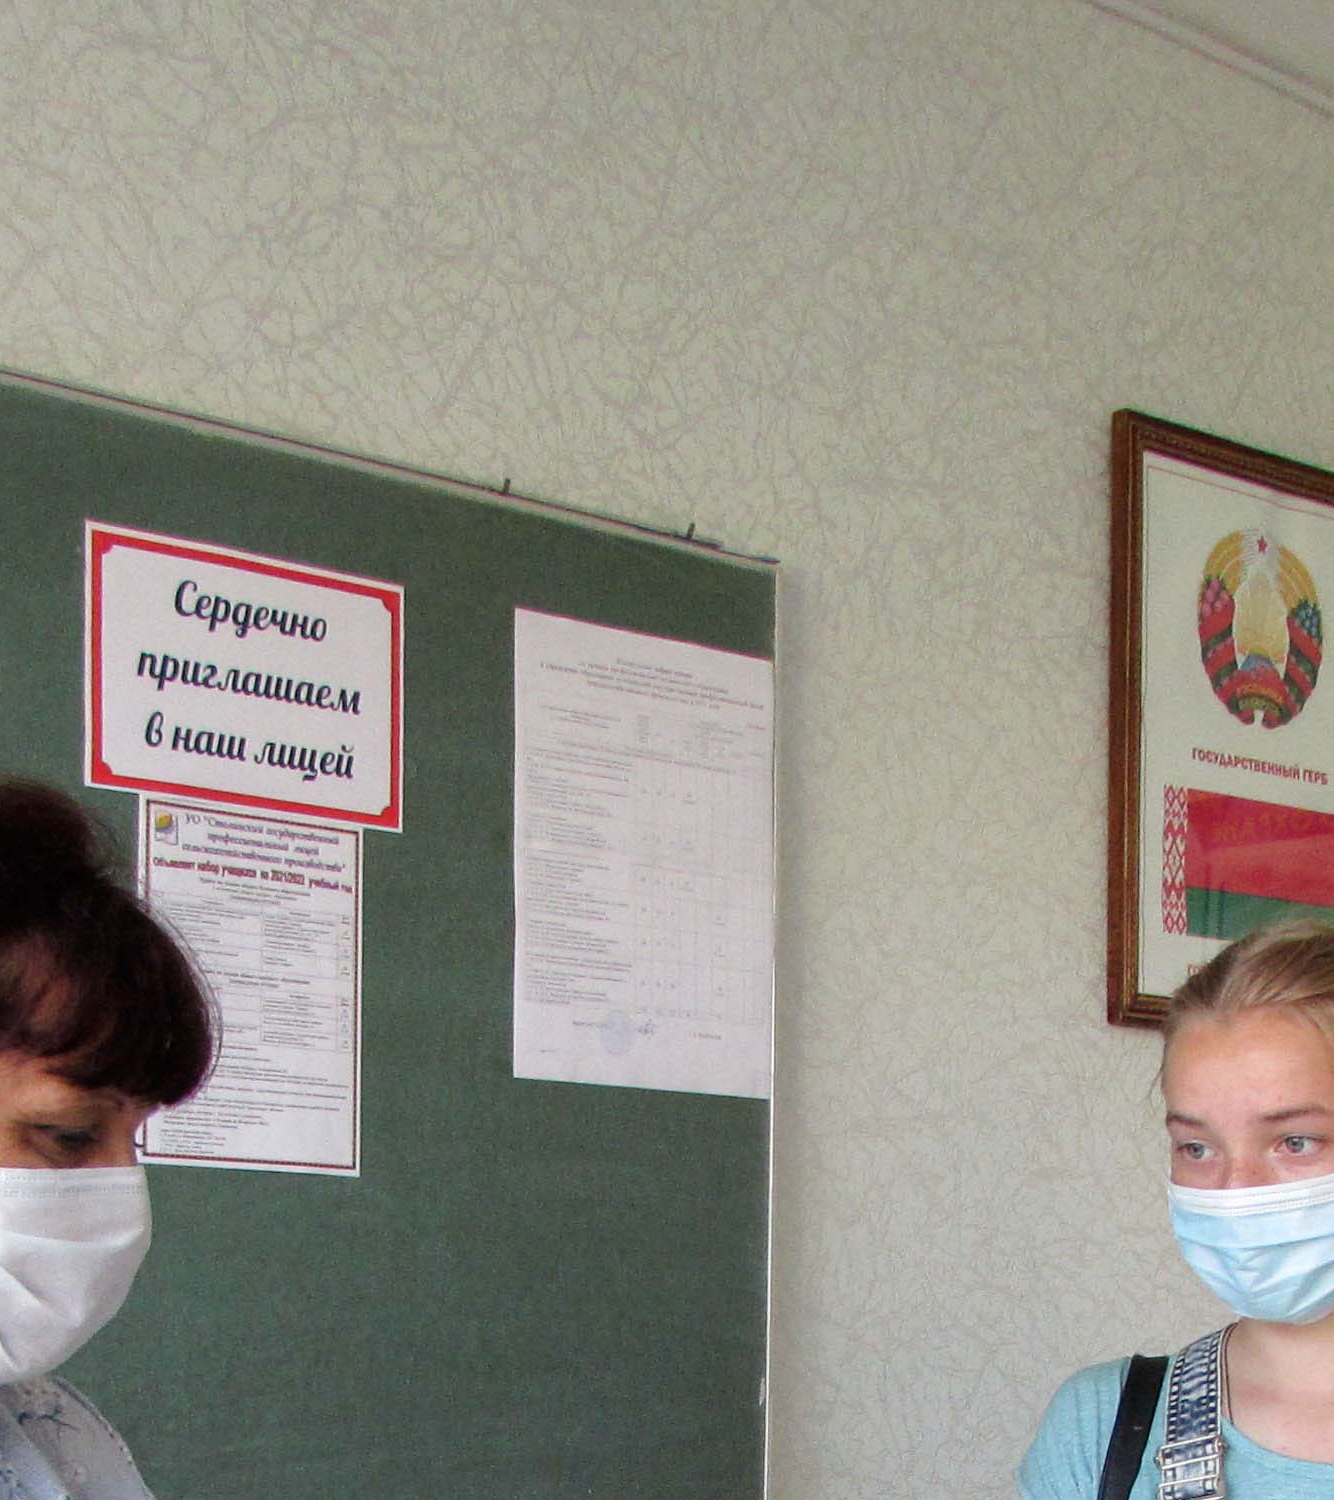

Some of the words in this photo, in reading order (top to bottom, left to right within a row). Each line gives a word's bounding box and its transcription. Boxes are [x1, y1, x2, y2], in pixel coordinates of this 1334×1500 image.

[174, 579, 327, 642] Сердечно
[136, 651, 361, 716] приглашаем
[145, 711, 164, 747] в
[171, 724, 247, 761] наш
[254, 741, 354, 782] лицей
[1192, 747, 1300, 781] ГОСУДАРСТВЕННЫЙ
[1302, 768, 1329, 785] ГЕРБ
